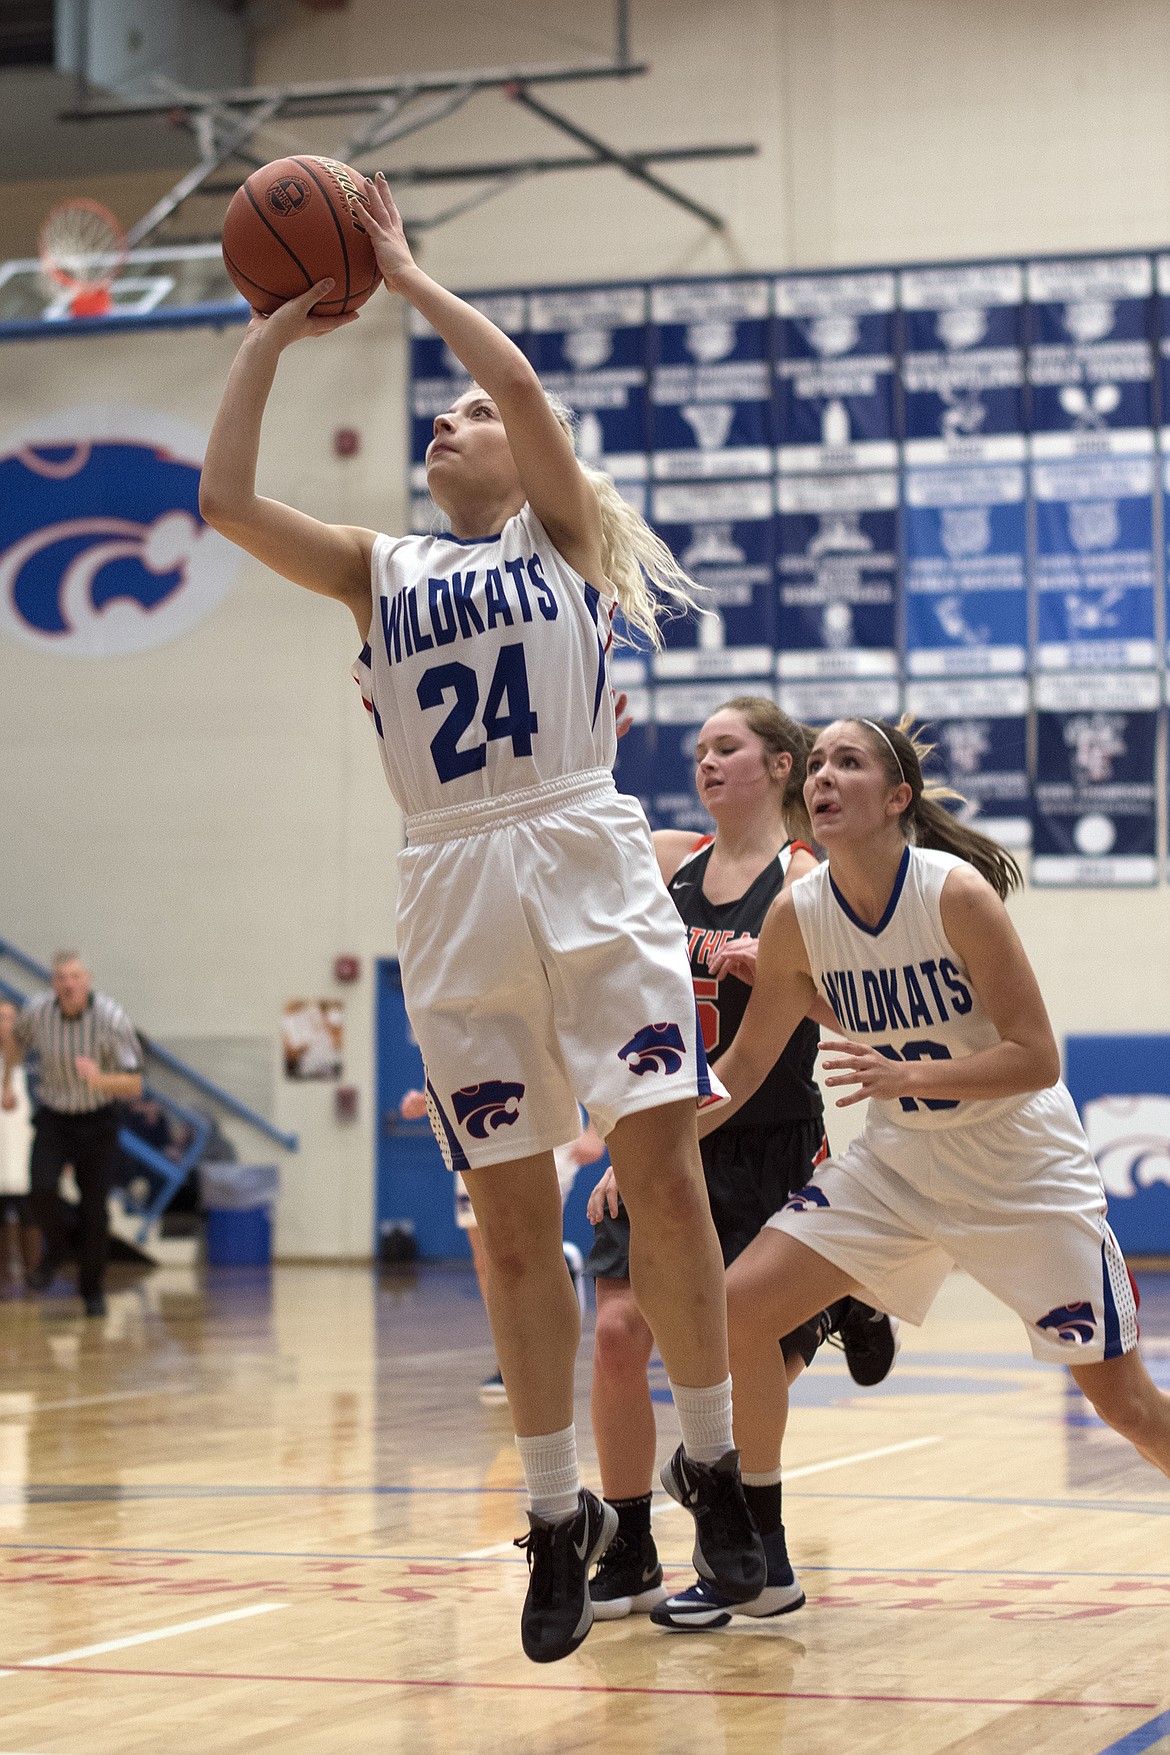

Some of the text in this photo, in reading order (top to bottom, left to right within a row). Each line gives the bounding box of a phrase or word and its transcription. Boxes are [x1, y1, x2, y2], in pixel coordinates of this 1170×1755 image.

[268, 184, 293, 217] MHSA
[380, 552, 559, 667] WILDKATS
[416, 642, 539, 785] 24
[821, 957, 974, 1034] WILDKATS
